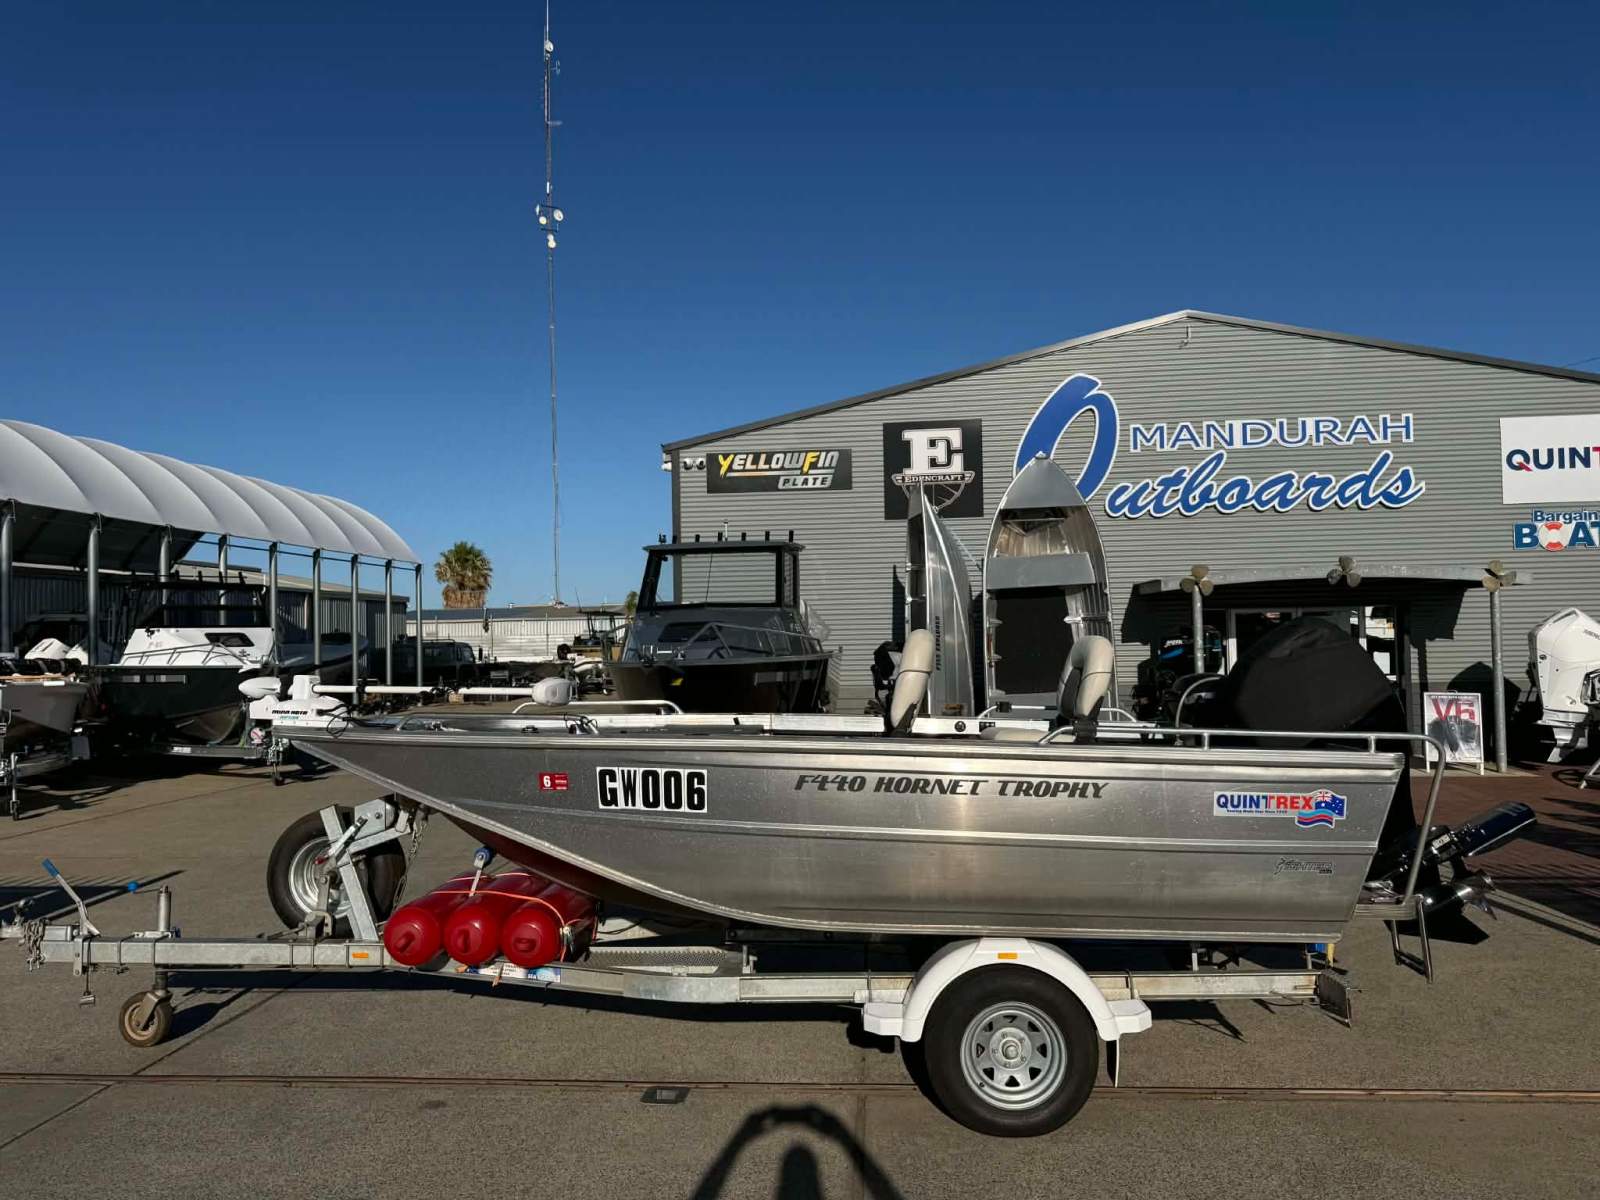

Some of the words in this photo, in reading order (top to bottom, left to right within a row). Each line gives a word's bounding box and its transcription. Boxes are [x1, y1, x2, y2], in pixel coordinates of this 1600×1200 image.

[1129, 413, 1415, 453] MANDURAH
[902, 428, 964, 474] E
[1012, 373, 1426, 519] Outboards
[782, 477, 828, 487] PLATE
[904, 474, 964, 483] EDENCRAFT
[1532, 510, 1599, 524] Bargain
[1431, 698, 1476, 721] V6
[543, 775, 551, 788] 6
[598, 768, 706, 811] GW006
[794, 774, 867, 792] F440
[873, 776, 989, 796] HORNET
[997, 779, 1110, 799] TROPHY
[1216, 793, 1314, 811] QUINTREX
